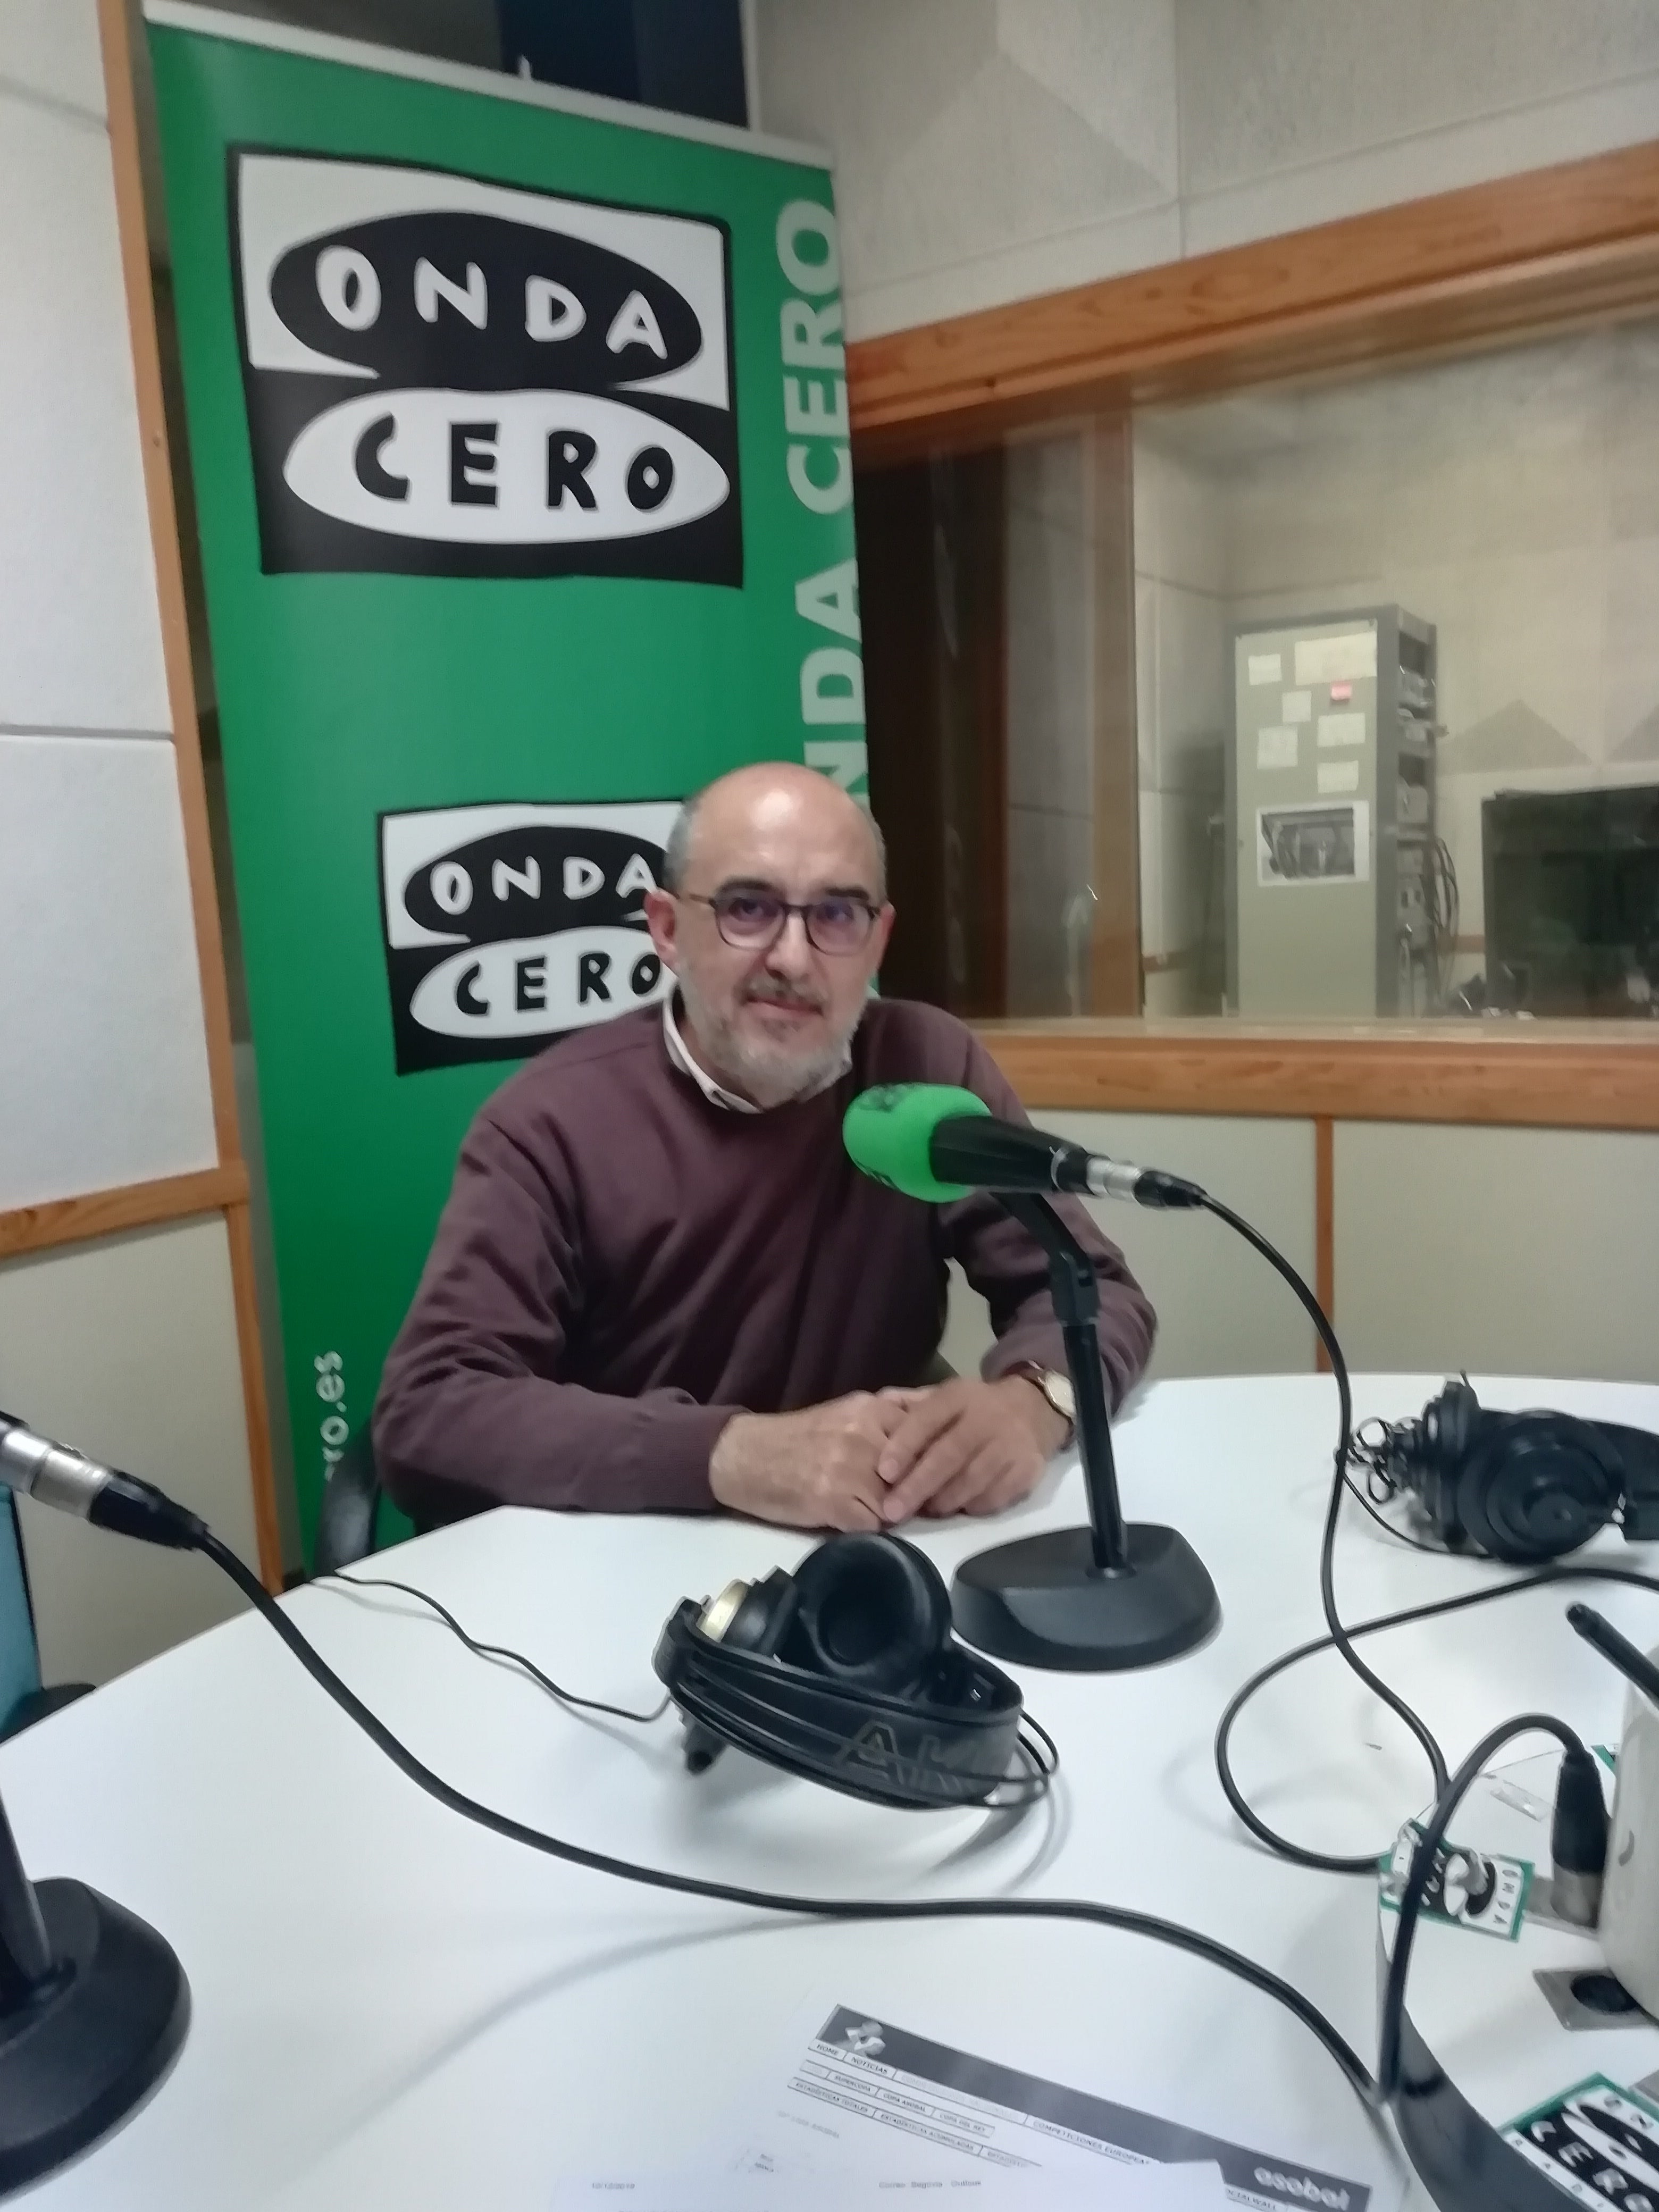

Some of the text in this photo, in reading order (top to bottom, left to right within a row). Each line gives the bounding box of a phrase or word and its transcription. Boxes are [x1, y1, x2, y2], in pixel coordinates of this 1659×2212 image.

[316, 245, 667, 359] ONDA
[355, 412, 674, 513] CERO
[776, 199, 870, 804] NDA CERO
[430, 853, 657, 915] ONDA
[455, 951, 661, 1017] CERO
[314, 1351, 349, 1481] ro.es
[816, 2044, 888, 2074] HOME NOTICIAS
